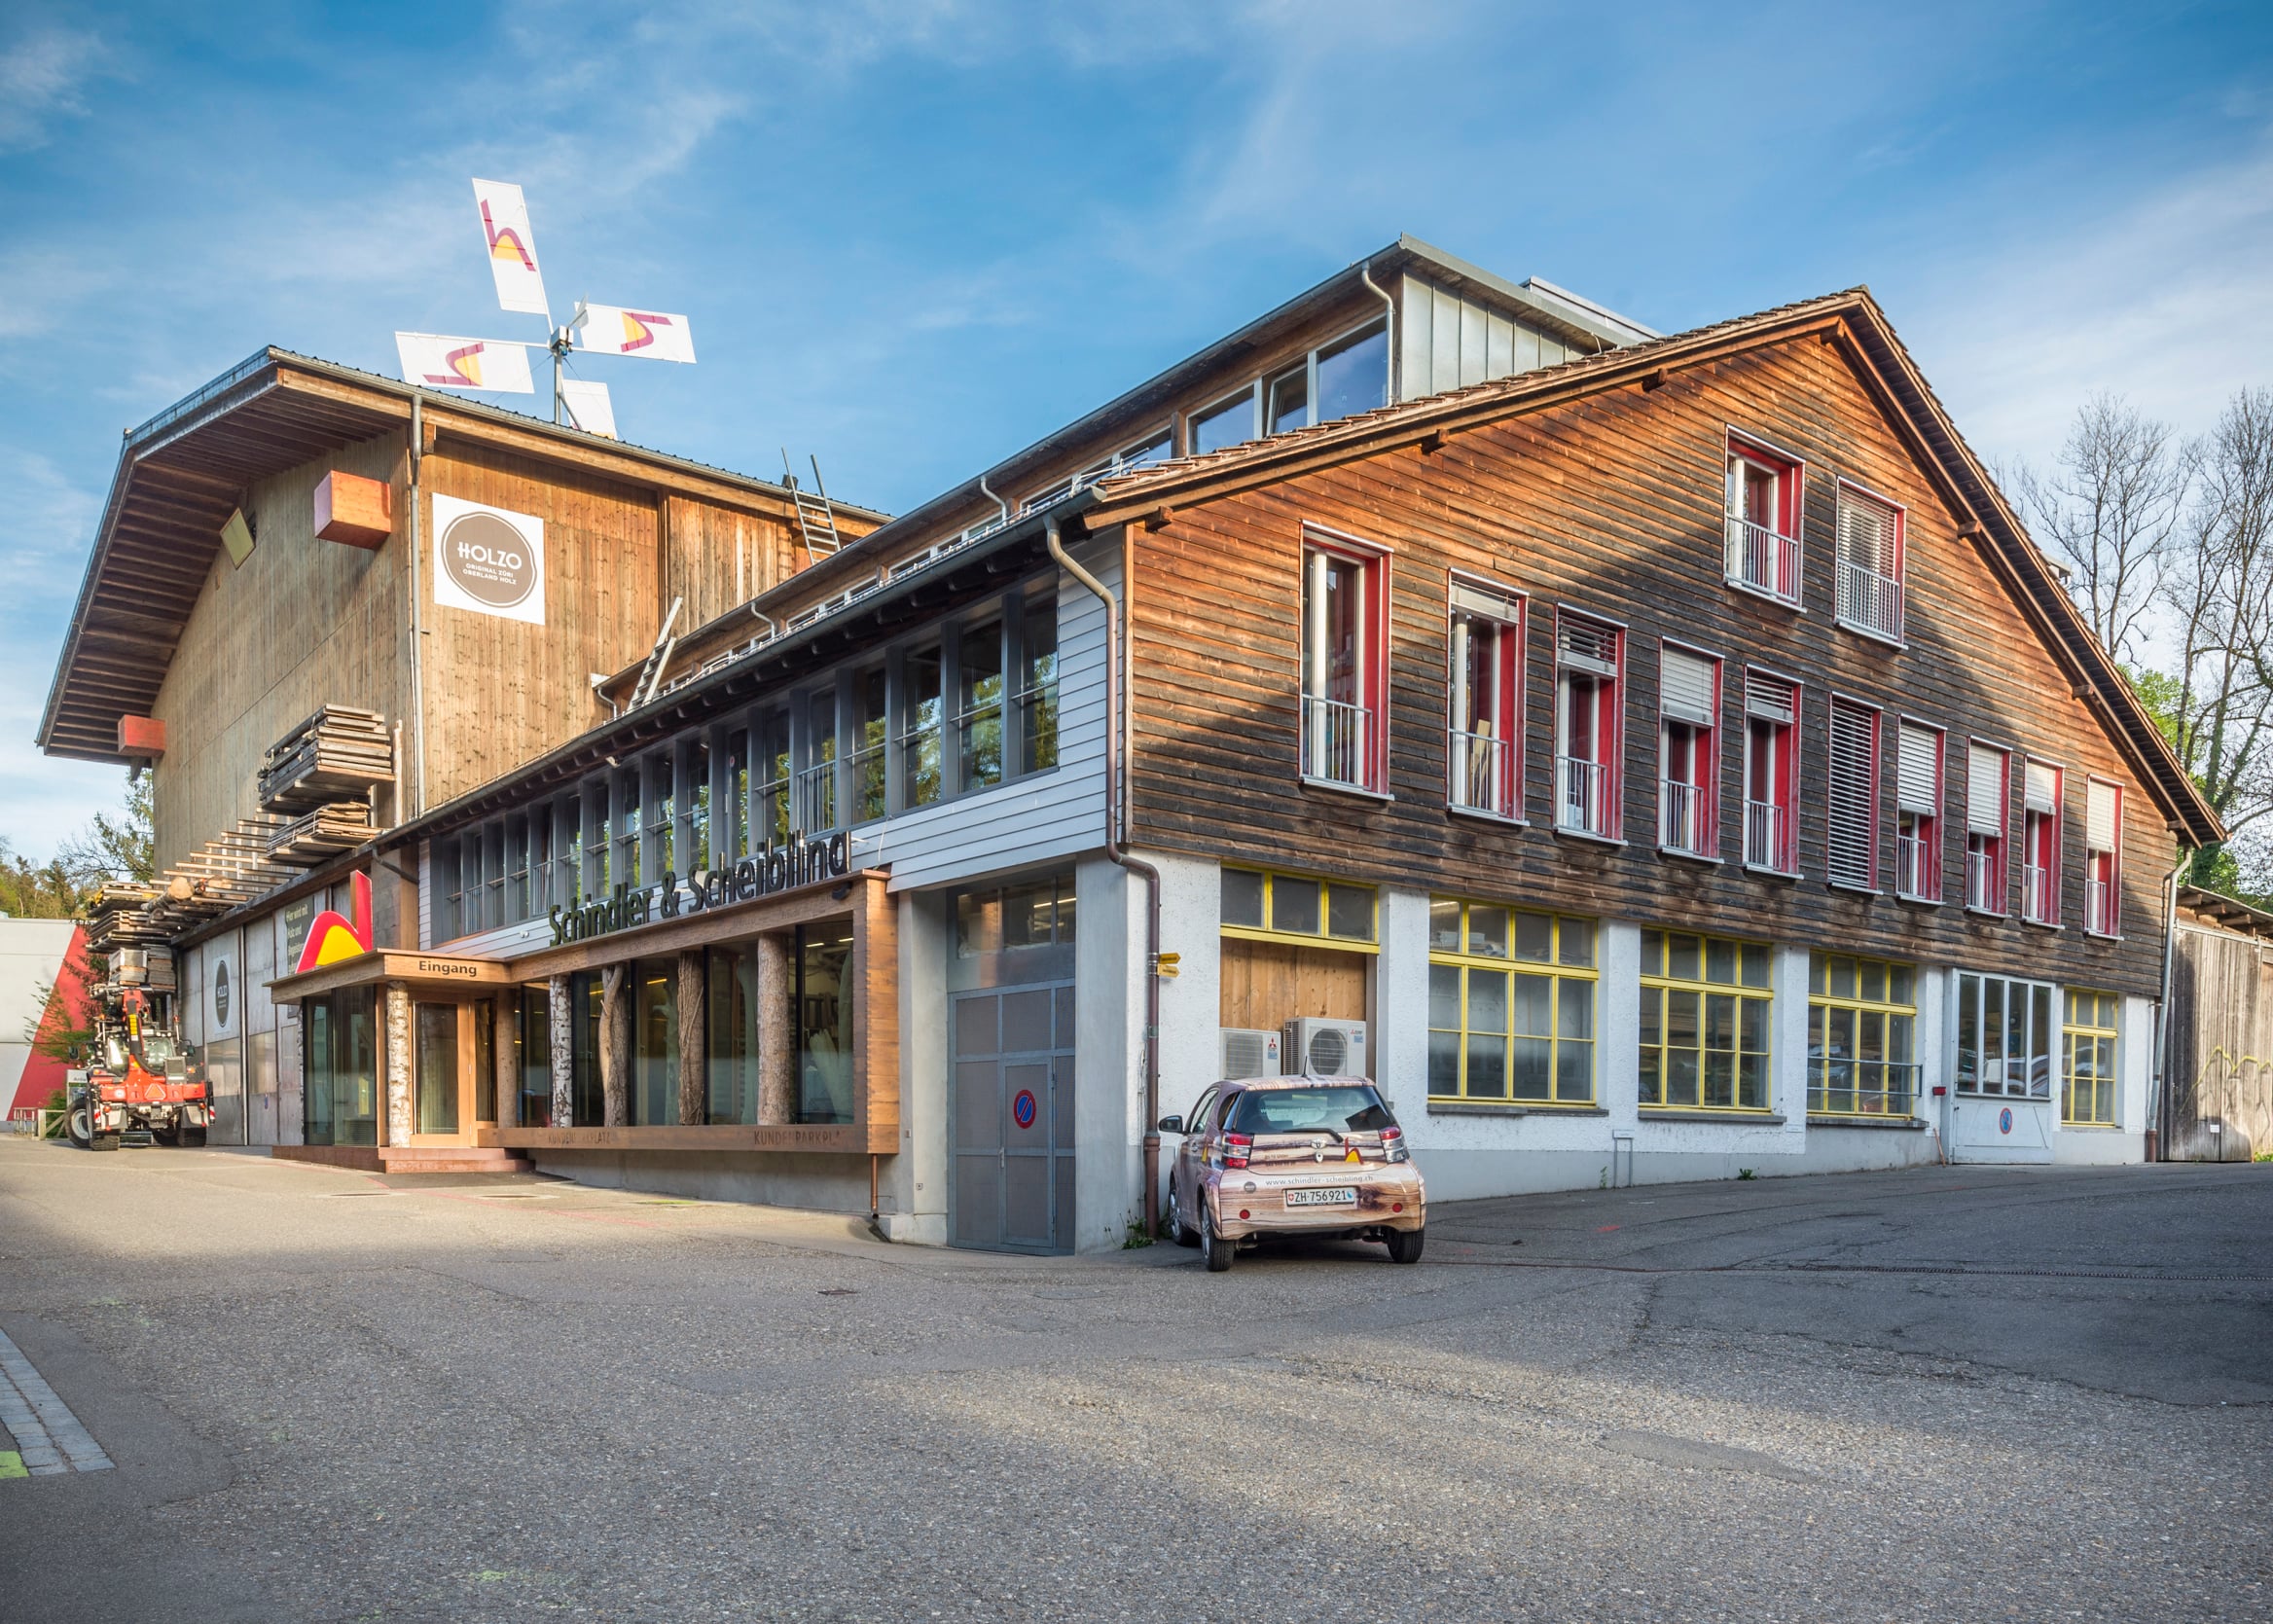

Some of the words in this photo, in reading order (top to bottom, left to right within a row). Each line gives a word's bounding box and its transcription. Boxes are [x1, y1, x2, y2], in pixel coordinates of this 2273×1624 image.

[457, 541, 522, 569] HOLZO
[462, 568, 498, 582] OBERLAND
[465, 562, 497, 575] ORIGINAL
[549, 882, 654, 947] Schindler
[661, 871, 680, 919] &
[687, 828, 853, 913] Scheibling
[418, 960, 477, 977] Eingang
